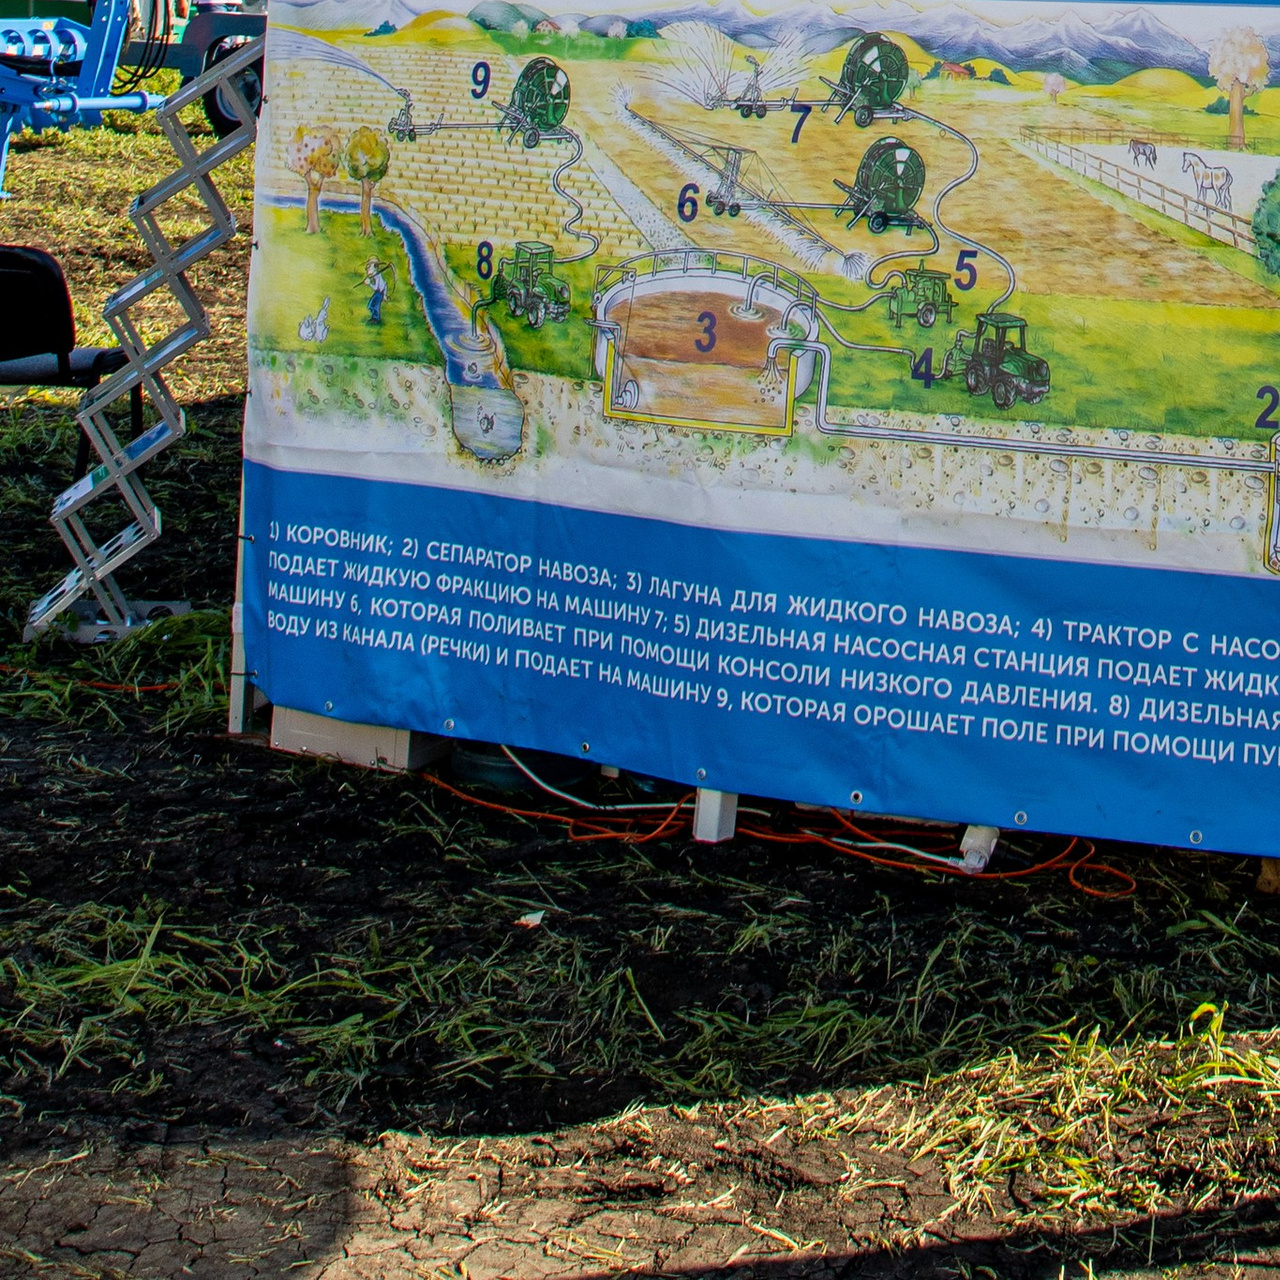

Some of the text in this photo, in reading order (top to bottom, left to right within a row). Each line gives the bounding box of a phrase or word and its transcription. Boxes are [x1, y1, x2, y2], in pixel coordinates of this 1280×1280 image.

[470, 61, 491, 100] 9
[791, 105, 812, 144] 7
[677, 182, 700, 223] 6
[476, 240, 493, 280] 8
[954, 249, 978, 291] 5
[694, 310, 718, 353] 3
[911, 348, 936, 389] 4
[1255, 385, 1280, 429] 2
[269, 521, 280, 541] 1)
[286, 525, 392, 557] КОРОВНИК;
[401, 538, 418, 559] 2)
[426, 541, 532, 573] СЕПАРАТОР
[538, 559, 616, 590] НАВОЗА;
[626, 572, 642, 594] 3)
[648, 577, 722, 607] ЛАГУНА
[730, 590, 777, 613] ДЛЯ
[787, 595, 907, 626] ЖИДКОГО
[918, 607, 1020, 639] НАВОЗА;
[1031, 618, 1053, 641] 4)
[1063, 620, 1172, 650] ТРАКТОР
[1182, 632, 1199, 653] С
[268, 550, 338, 577] ПОДАЕТ
[342, 562, 431, 590] ЖИДКУЮ
[435, 574, 531, 606] ФРАКЦИЮ
[536, 590, 559, 611] НА
[564, 595, 650, 626] МАШИНУ
[655, 610, 666, 633] 7;
[674, 615, 690, 637] 5)
[695, 618, 826, 652] ДИЗЕЛЬНАЯ
[833, 633, 966, 666] НАСОСНАЯ
[973, 647, 1089, 678] СТАНЦИЯ
[1097, 659, 1198, 687] ПОДАЕТ
[268, 582, 345, 609] МАШИНУ
[350, 595, 364, 618] 6,
[370, 597, 461, 626] КОТОРАЯ
[468, 610, 566, 643] ПОЛИВАЕТ
[573, 628, 613, 651] ПРИ
[620, 636, 709, 672] ПОМОЩИ
[718, 655, 830, 687] КОНСОЛИ
[840, 669, 953, 699] НИЗКОГО
[960, 681, 1098, 713] ДАВЛЕНИЯ.
[1109, 695, 1130, 719] 8)
[268, 610, 310, 637] ВОДУ
[315, 620, 337, 640] ИЗ
[342, 625, 415, 652] КАНАЛА
[420, 634, 490, 665] (РЕЧКИ)
[496, 647, 508, 666] И
[515, 650, 593, 679] ПОДАЕТ
[599, 664, 622, 685] НА
[627, 670, 711, 704] МАШИНУ
[716, 688, 732, 711] 9,
[740, 691, 846, 723] КОТОРАЯ
[853, 705, 975, 736] ОРОШАЕТ
[981, 717, 1048, 744] ПОЛЕ
[1056, 725, 1104, 749] ПРИ
[1113, 730, 1235, 764] ПОМОЩИ
